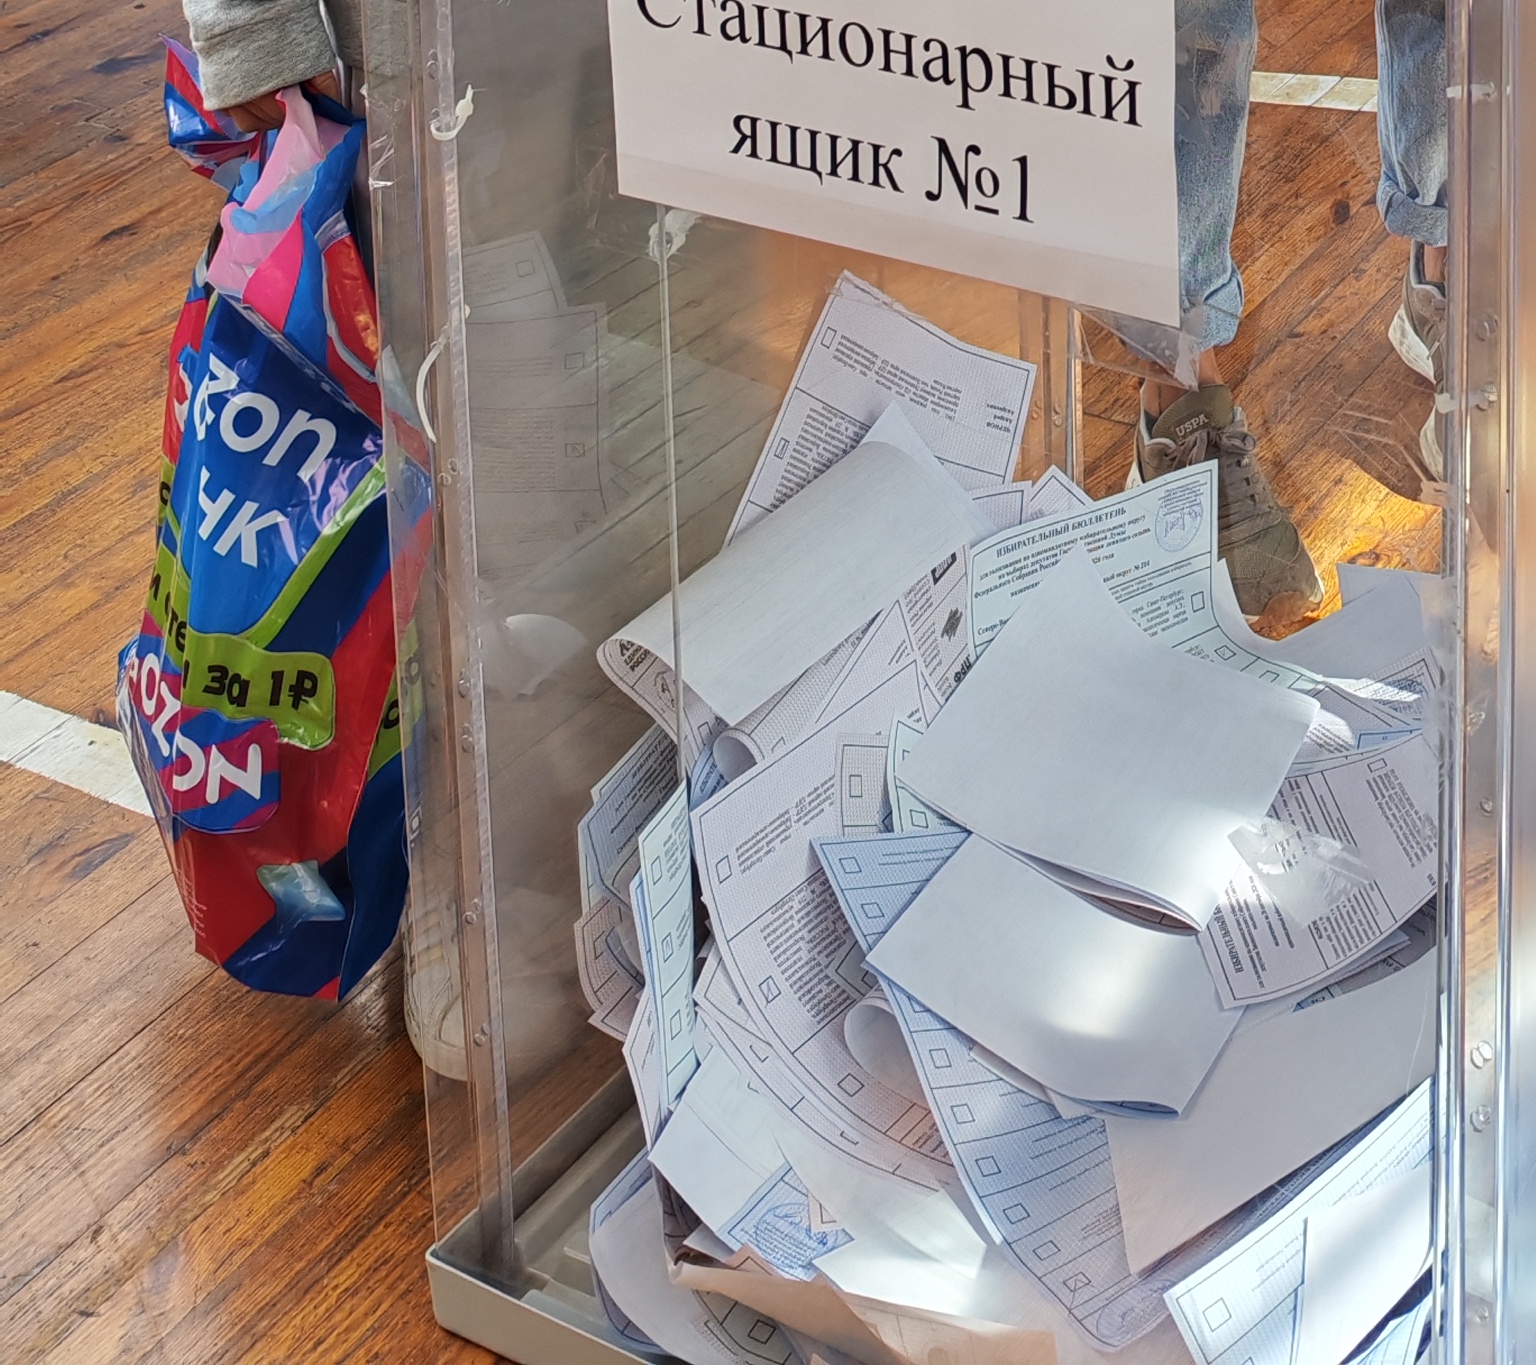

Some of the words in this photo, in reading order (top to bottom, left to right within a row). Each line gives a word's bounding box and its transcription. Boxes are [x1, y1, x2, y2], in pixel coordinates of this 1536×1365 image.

[729, 114, 904, 193] ящик
[925, 136, 1035, 224] №1
[1175, 413, 1209, 437] USPA
[996, 521, 1070, 559] ИЗБИРАТЕЛЬНЫЙ
[1070, 506, 1127, 536] БЮЛЛЕТЕНЬ
[1215, 903, 1245, 975] ИЗБИРАТЕЛЬНЫЙ
